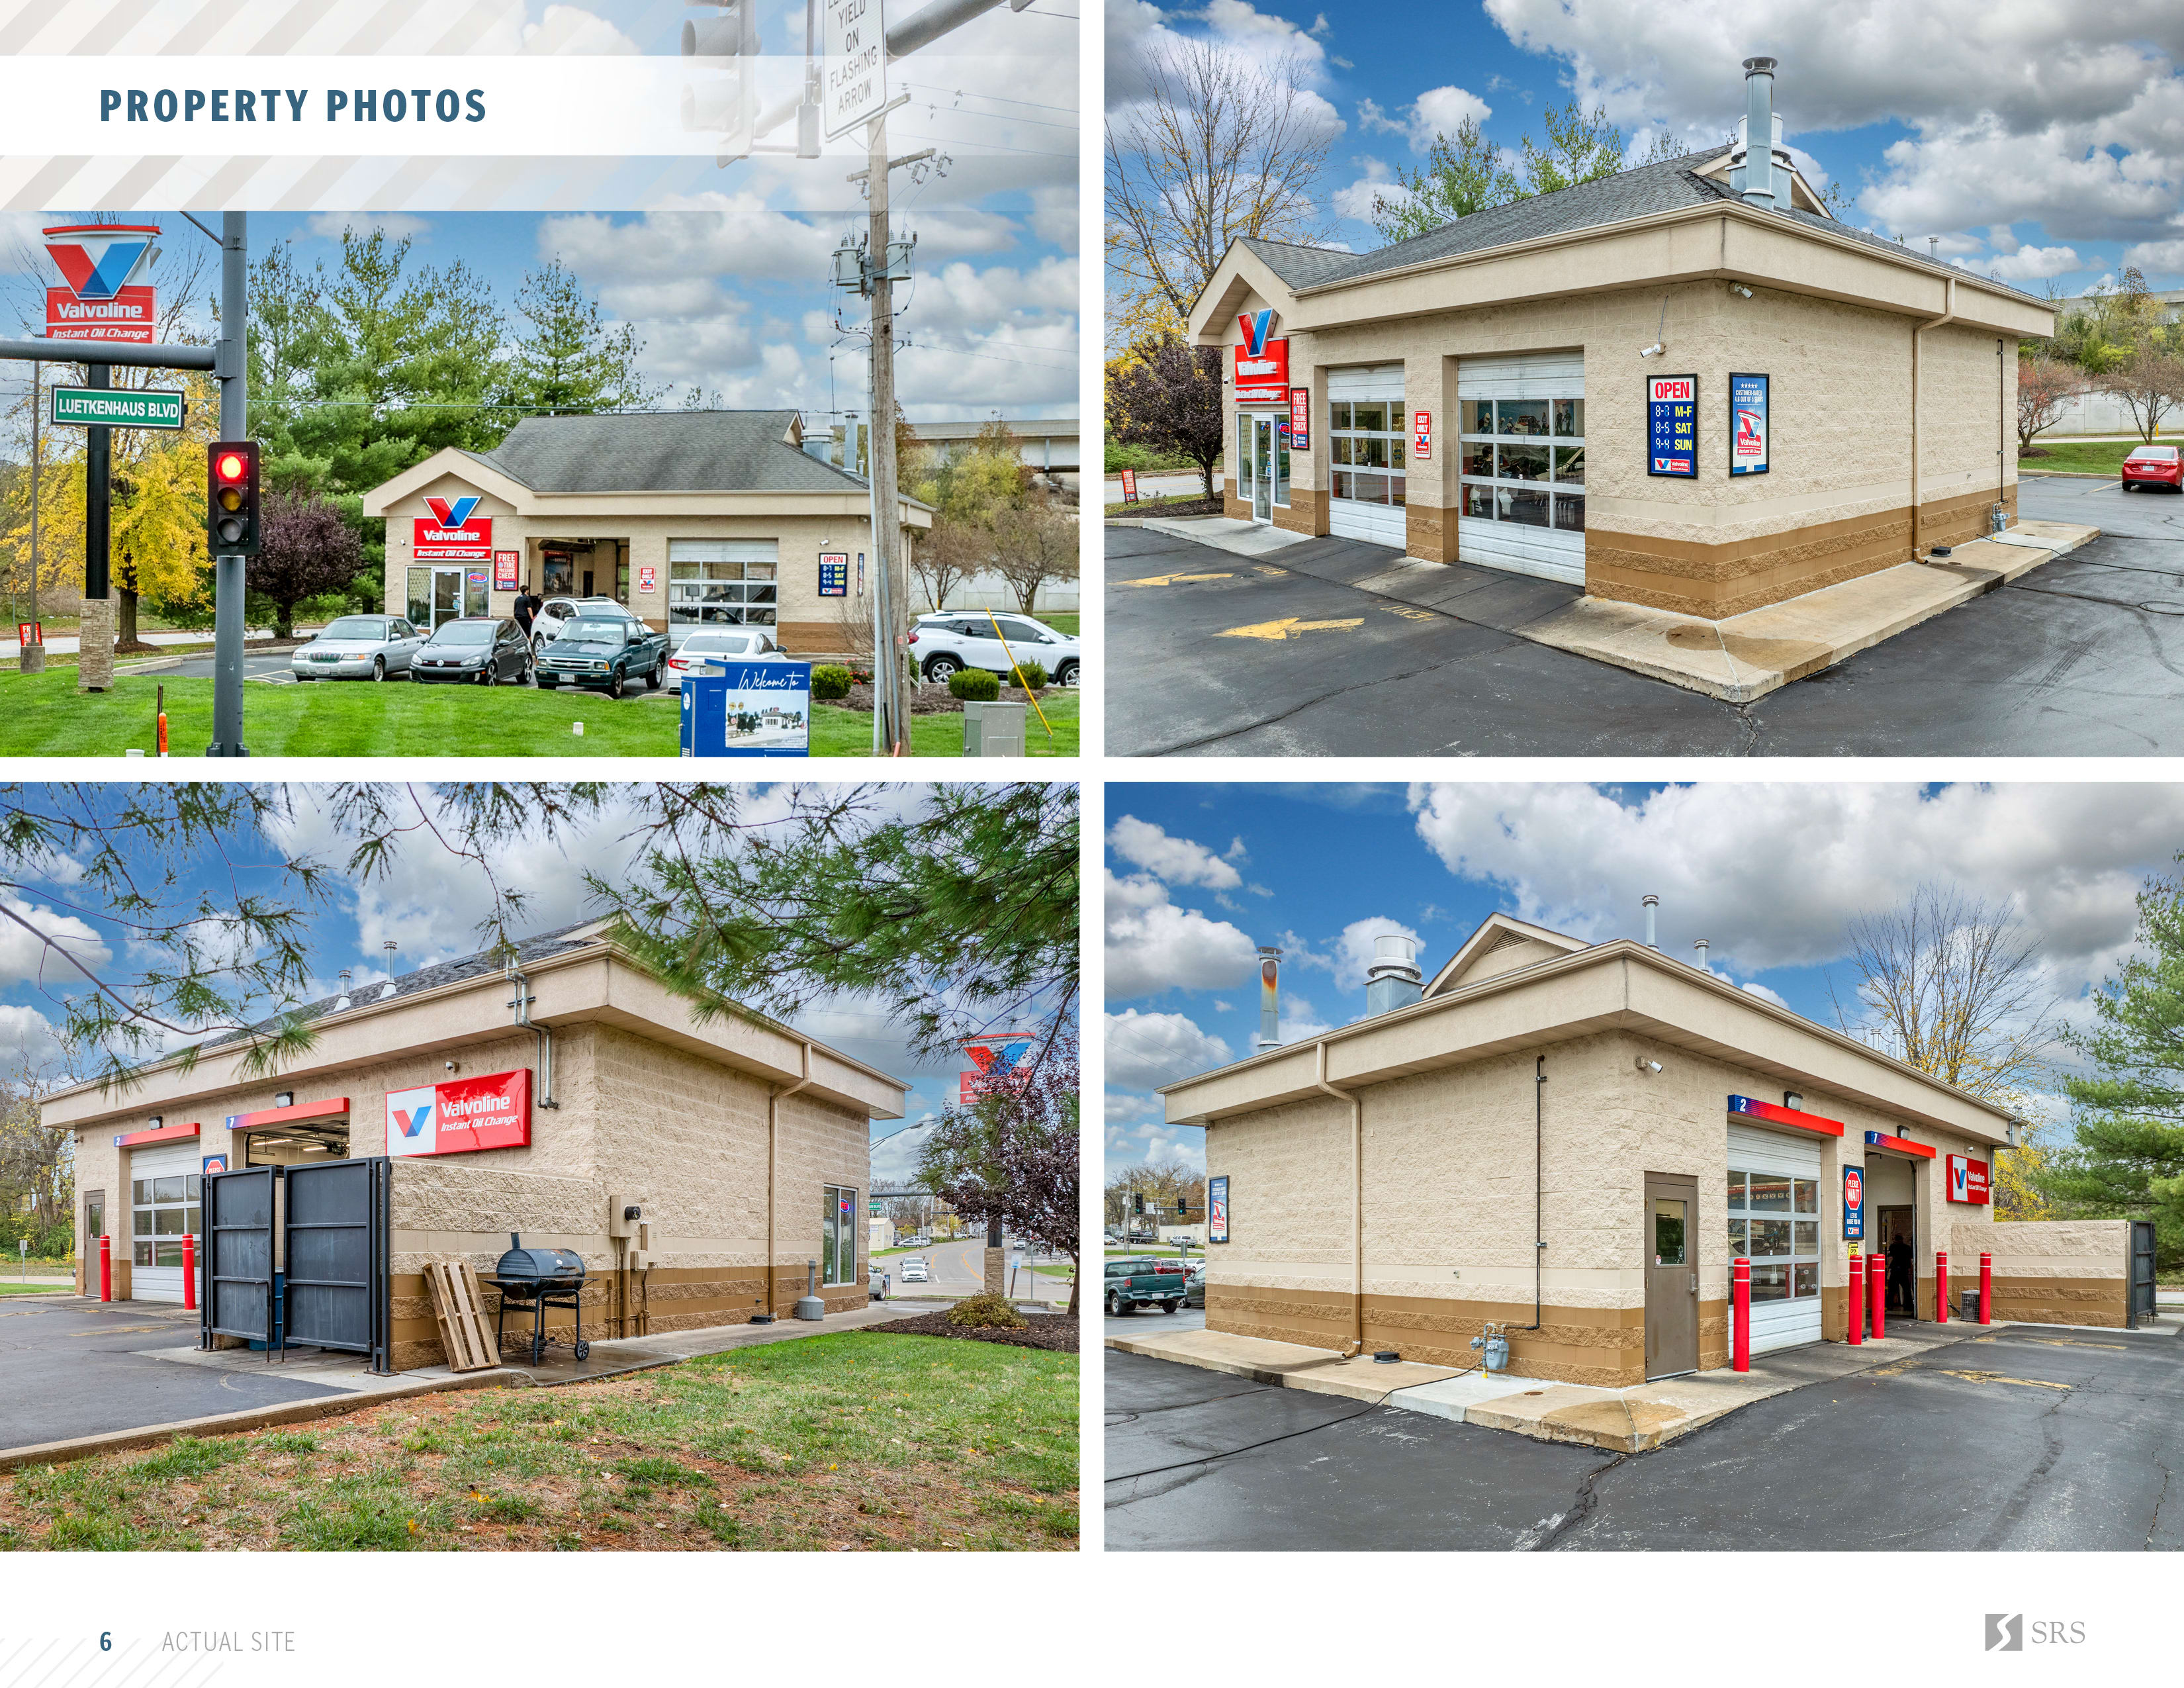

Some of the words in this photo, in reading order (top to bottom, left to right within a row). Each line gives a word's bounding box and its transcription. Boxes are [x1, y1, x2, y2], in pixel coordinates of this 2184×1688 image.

[839, 0, 866, 28] YIELD
[846, 27, 859, 52] ON
[830, 45, 878, 91] FLASHING
[838, 78, 872, 115] ARROW
[56, 302, 143, 318] Valvoline
[52, 329, 89, 339] Instant
[91, 328, 105, 338] Oil
[107, 328, 150, 340] Change
[1655, 381, 1690, 399] OPEN
[1293, 393, 1306, 405] FREE
[59, 399, 146, 416] LUETKENHAUS
[148, 403, 179, 418] BLVD
[1297, 405, 1306, 415] TIRE
[1674, 406, 1692, 417] M-F
[1417, 415, 1428, 424] EXIT
[1293, 421, 1306, 431] CHECK
[1416, 424, 1428, 433] ONLY
[1655, 421, 1670, 434] 8-5
[1675, 422, 1692, 434] SAT
[1674, 439, 1692, 451] SUN
[1740, 438, 1760, 447] Valvoline
[423, 530, 480, 541] Valvoline
[456, 550, 486, 559] Change
[738, 669, 787, 690] Welcome
[786, 671, 804, 692] to
[441, 1096, 510, 1117] Valvoline
[1739, 1098, 1747, 1112] 2
[441, 1119, 471, 1131] Instant
[471, 1117, 483, 1128] Oil
[484, 1115, 518, 1126] Change
[115, 1137, 121, 1147] 2
[1874, 1133, 1878, 1143] 1
[1968, 1170, 1985, 1183] Valvoline
[1848, 1180, 1858, 1188] PLEASE
[1847, 1188, 1860, 1201] WAIT
